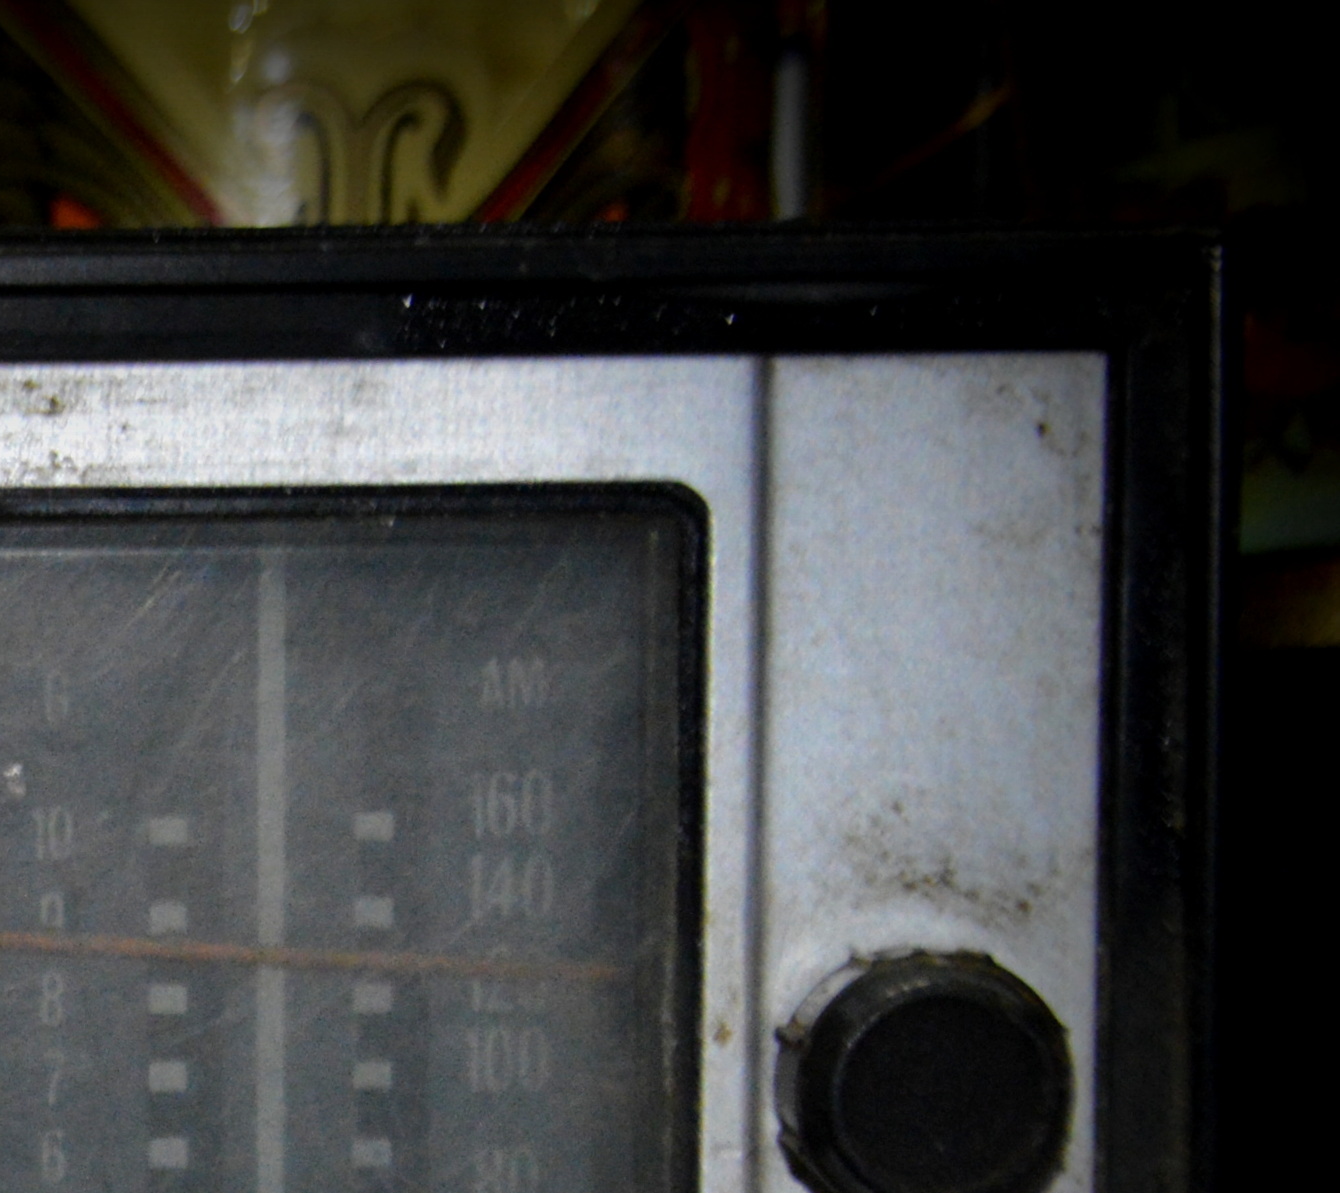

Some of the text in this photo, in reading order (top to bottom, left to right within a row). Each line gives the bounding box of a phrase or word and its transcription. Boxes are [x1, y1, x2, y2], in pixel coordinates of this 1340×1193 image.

[470, 767, 554, 840] 160
[468, 852, 556, 921] 140
[39, 968, 67, 1029] 8
[468, 1023, 552, 1094] 100
[39, 1126, 68, 1187] 6
